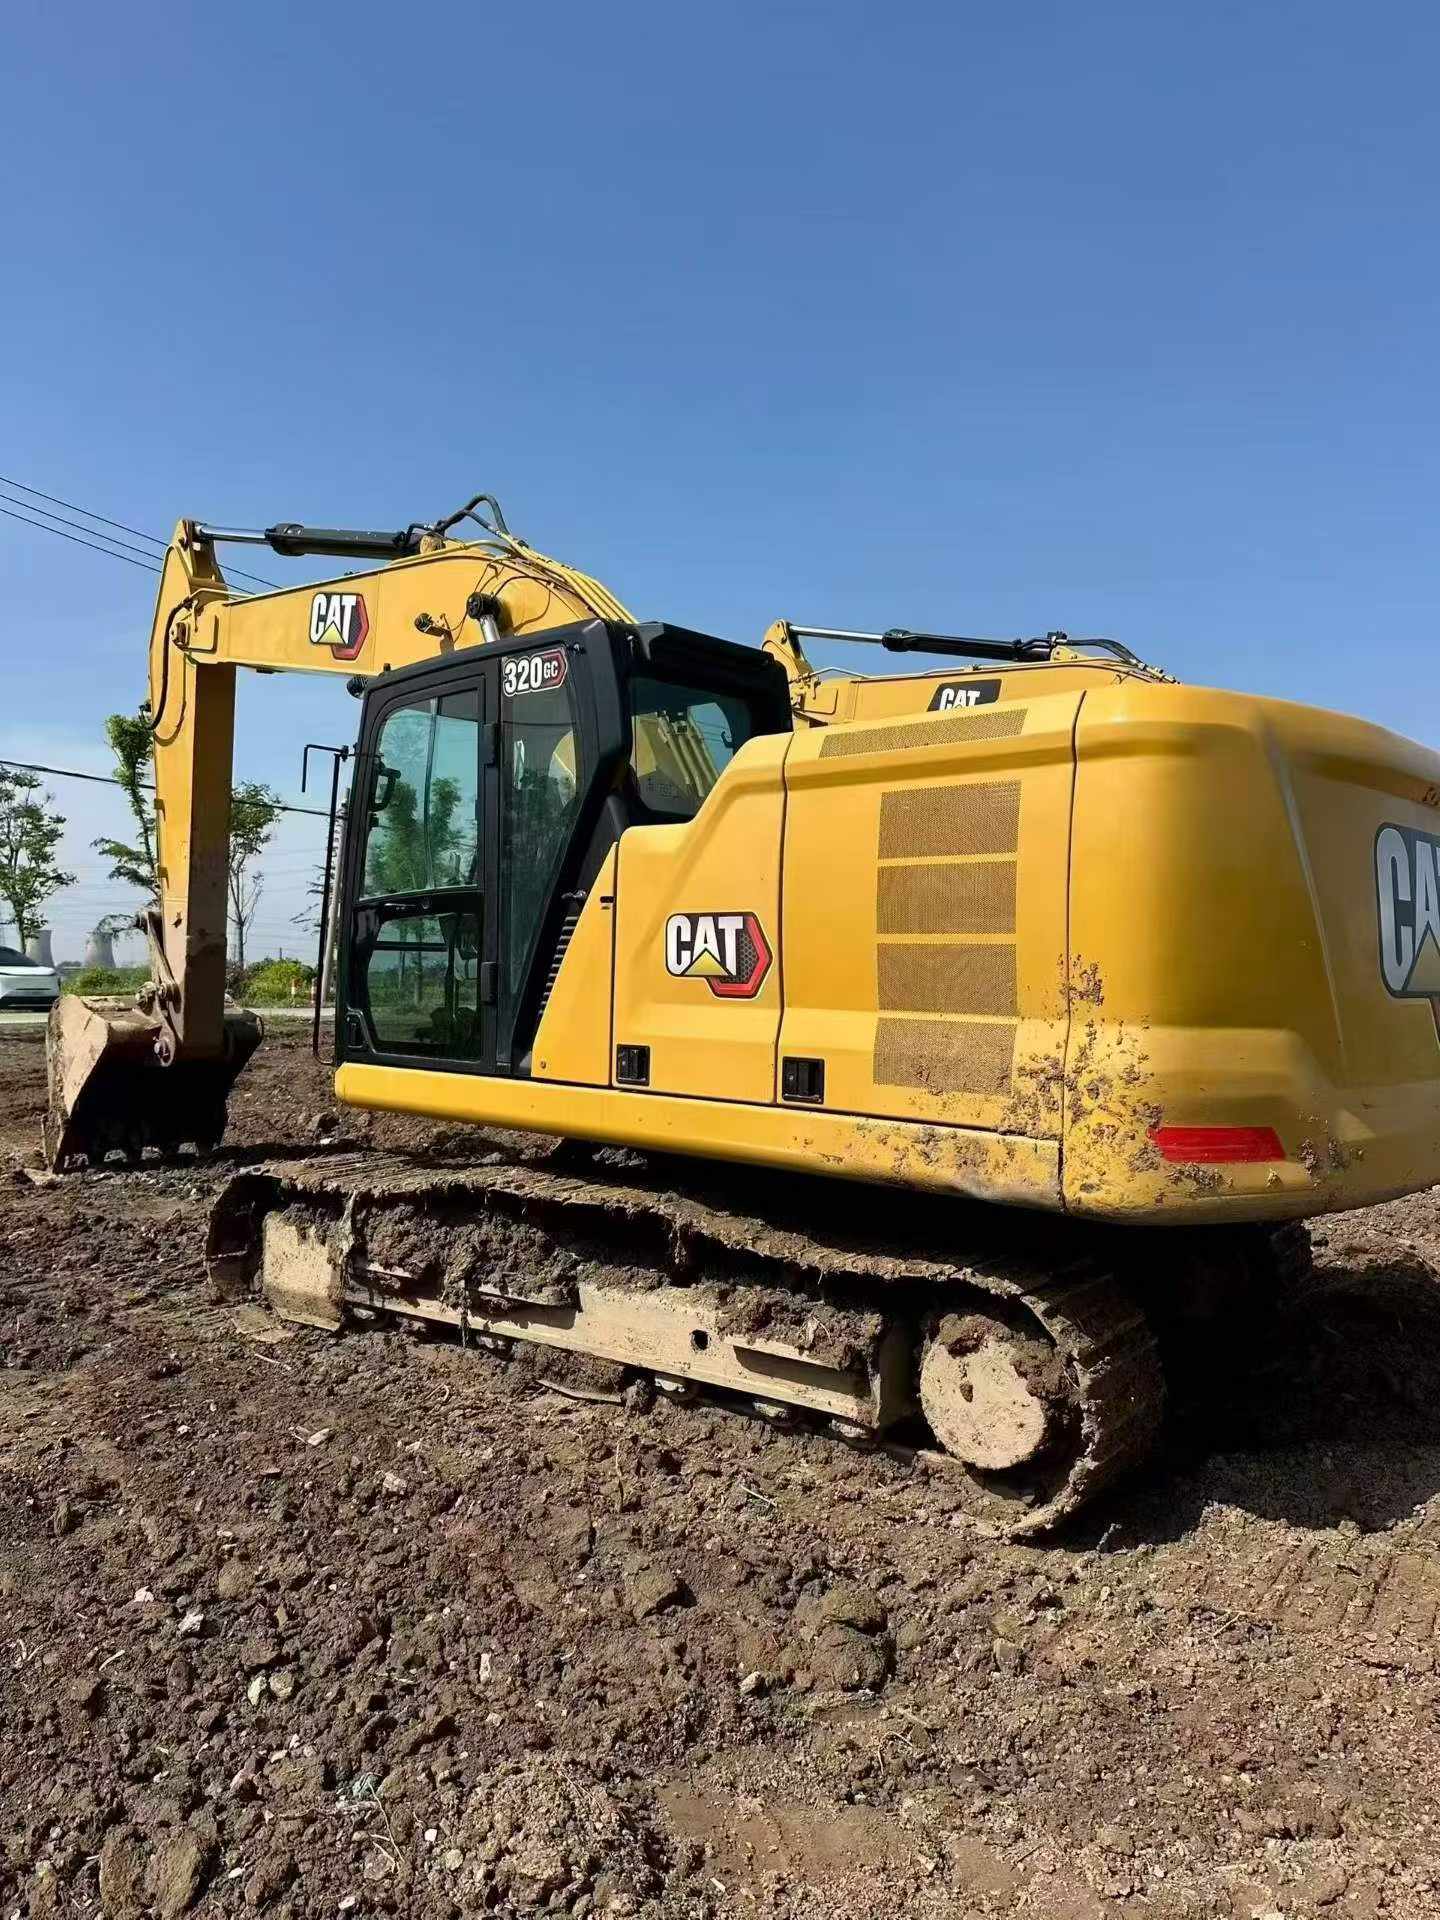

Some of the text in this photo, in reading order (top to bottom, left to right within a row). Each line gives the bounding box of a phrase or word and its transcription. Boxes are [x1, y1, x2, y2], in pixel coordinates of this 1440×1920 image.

[310, 593, 356, 644] CAT
[939, 688, 980, 712] CAT
[1376, 827, 1440, 992] CA
[667, 914, 744, 976] CAT
